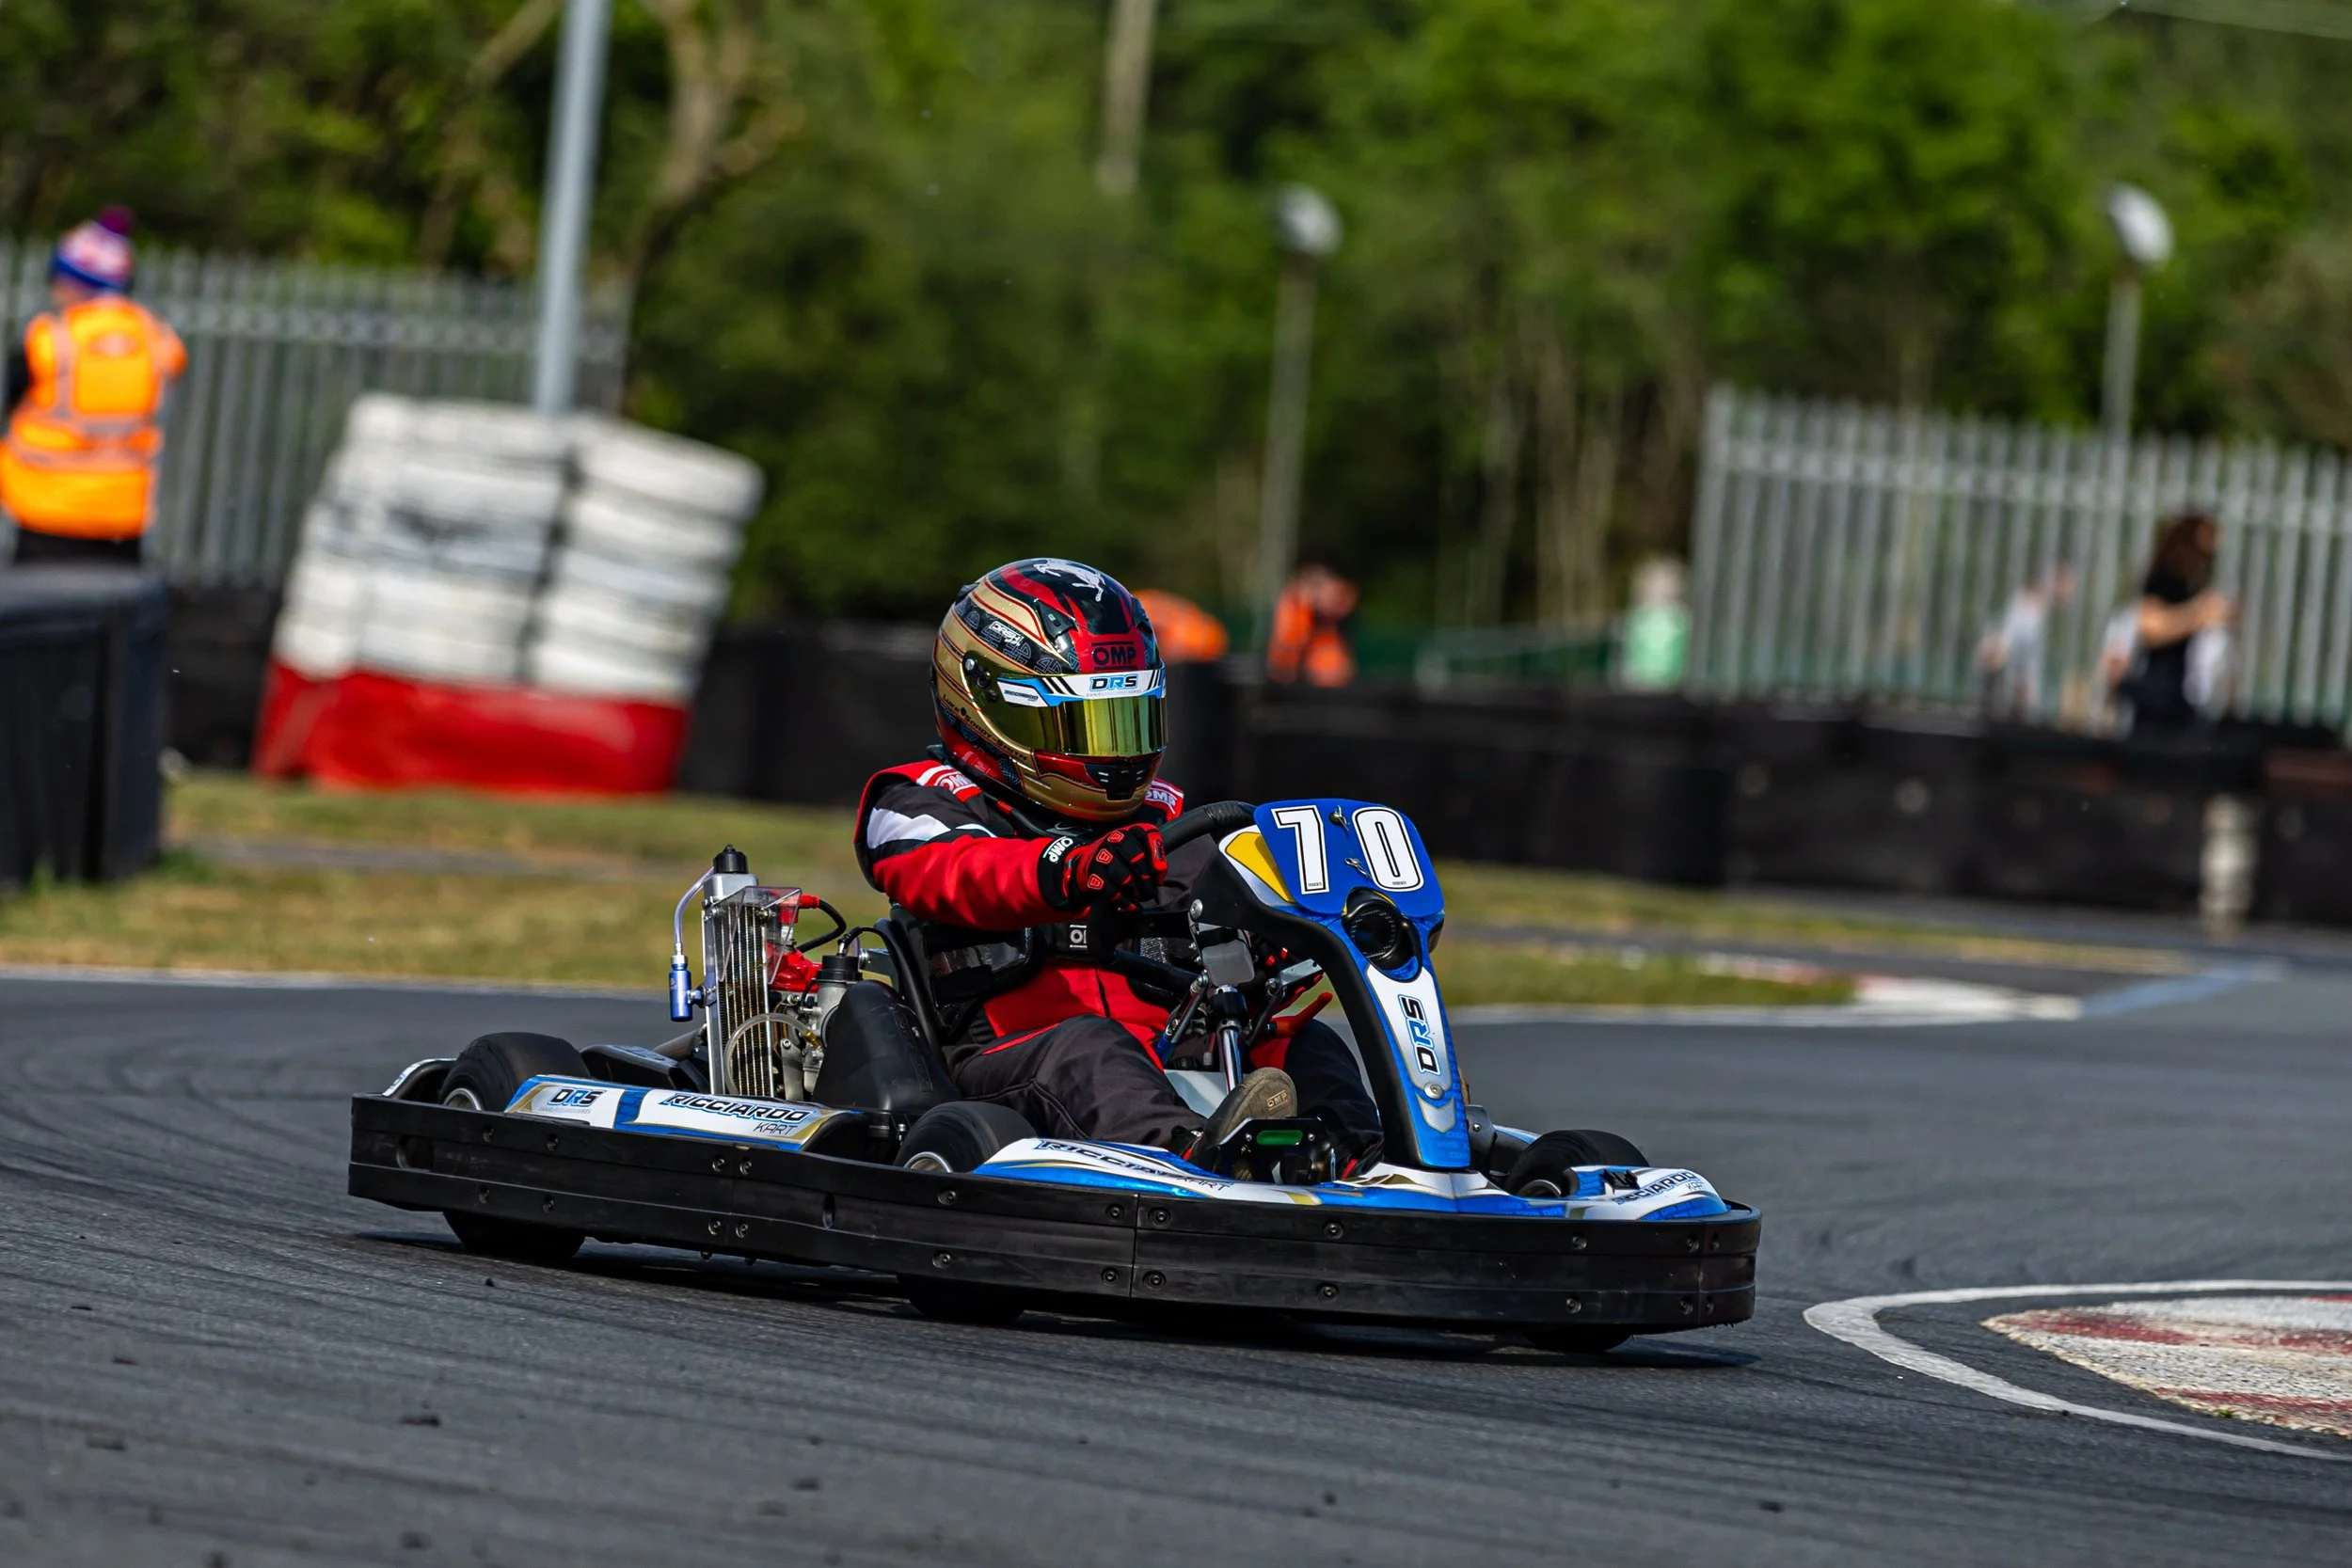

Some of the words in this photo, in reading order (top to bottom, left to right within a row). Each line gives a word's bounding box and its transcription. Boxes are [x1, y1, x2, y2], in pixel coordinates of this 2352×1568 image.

[1092, 646, 1136, 666] OMP
[1090, 674, 1138, 691] DRS
[940, 773, 974, 792] OM
[1049, 837, 1073, 863] OMP
[1271, 805, 1424, 895] 70
[1399, 995, 1439, 1074] DRS
[548, 1088, 604, 1105] DRS
[1267, 1092, 1287, 1107] OMP
[663, 1093, 812, 1123] RICCIARDO
[754, 1122, 798, 1135] KART
